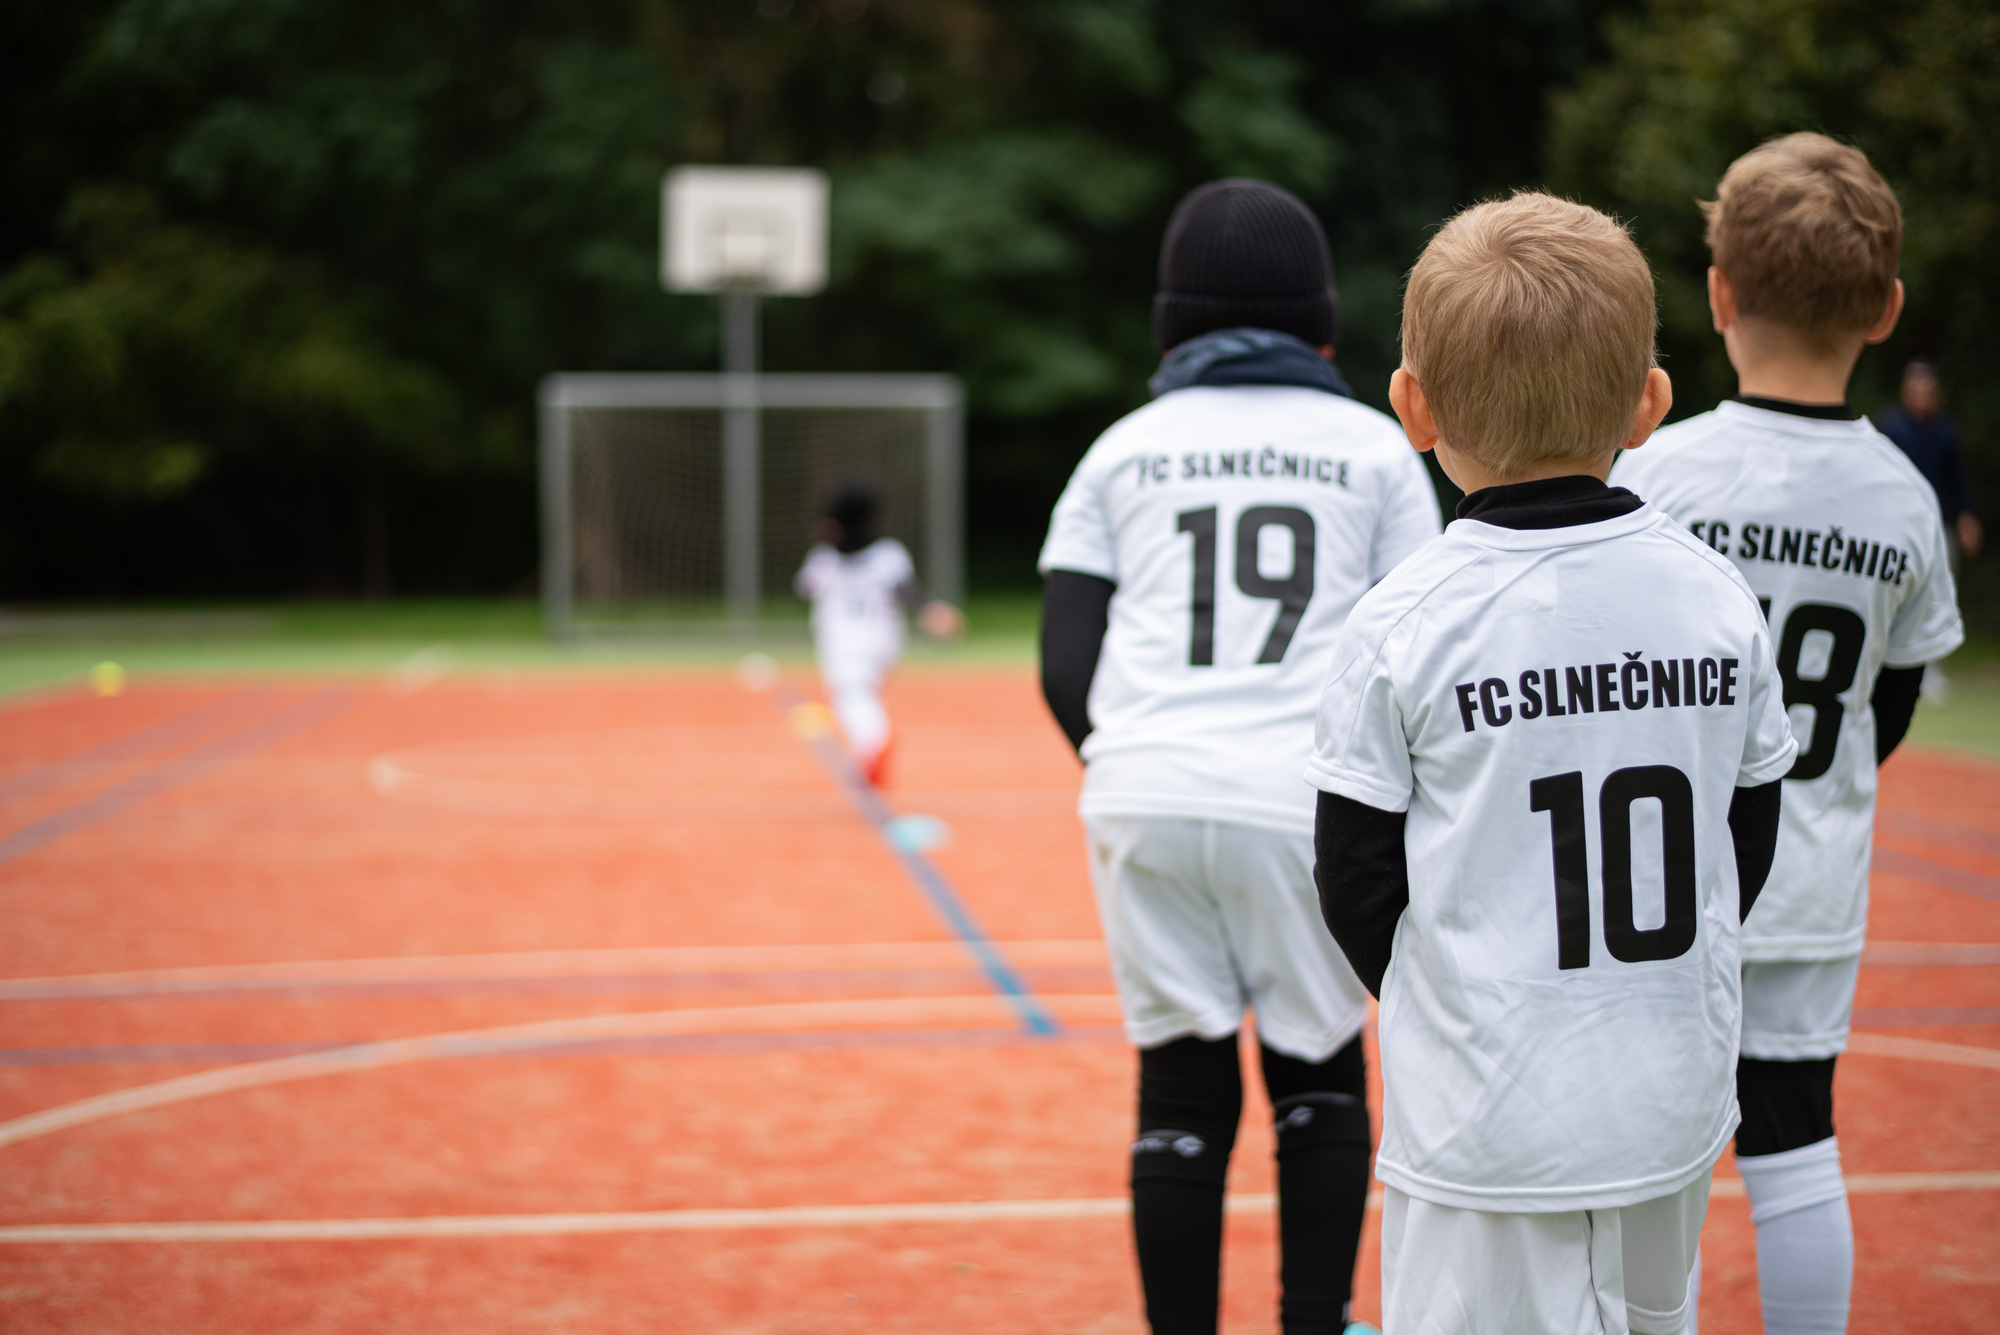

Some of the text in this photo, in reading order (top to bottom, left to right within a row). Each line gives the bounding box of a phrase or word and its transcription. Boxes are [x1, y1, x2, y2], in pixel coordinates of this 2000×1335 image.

[1181, 446, 1350, 488] SLNEČNICE
[1176, 504, 1315, 667] 19
[1739, 522, 1908, 586] SLNEČNICE
[1455, 651, 1739, 733] FC SLNEČNICE
[1756, 596, 1866, 780] 8
[1530, 764, 1697, 970] 10
